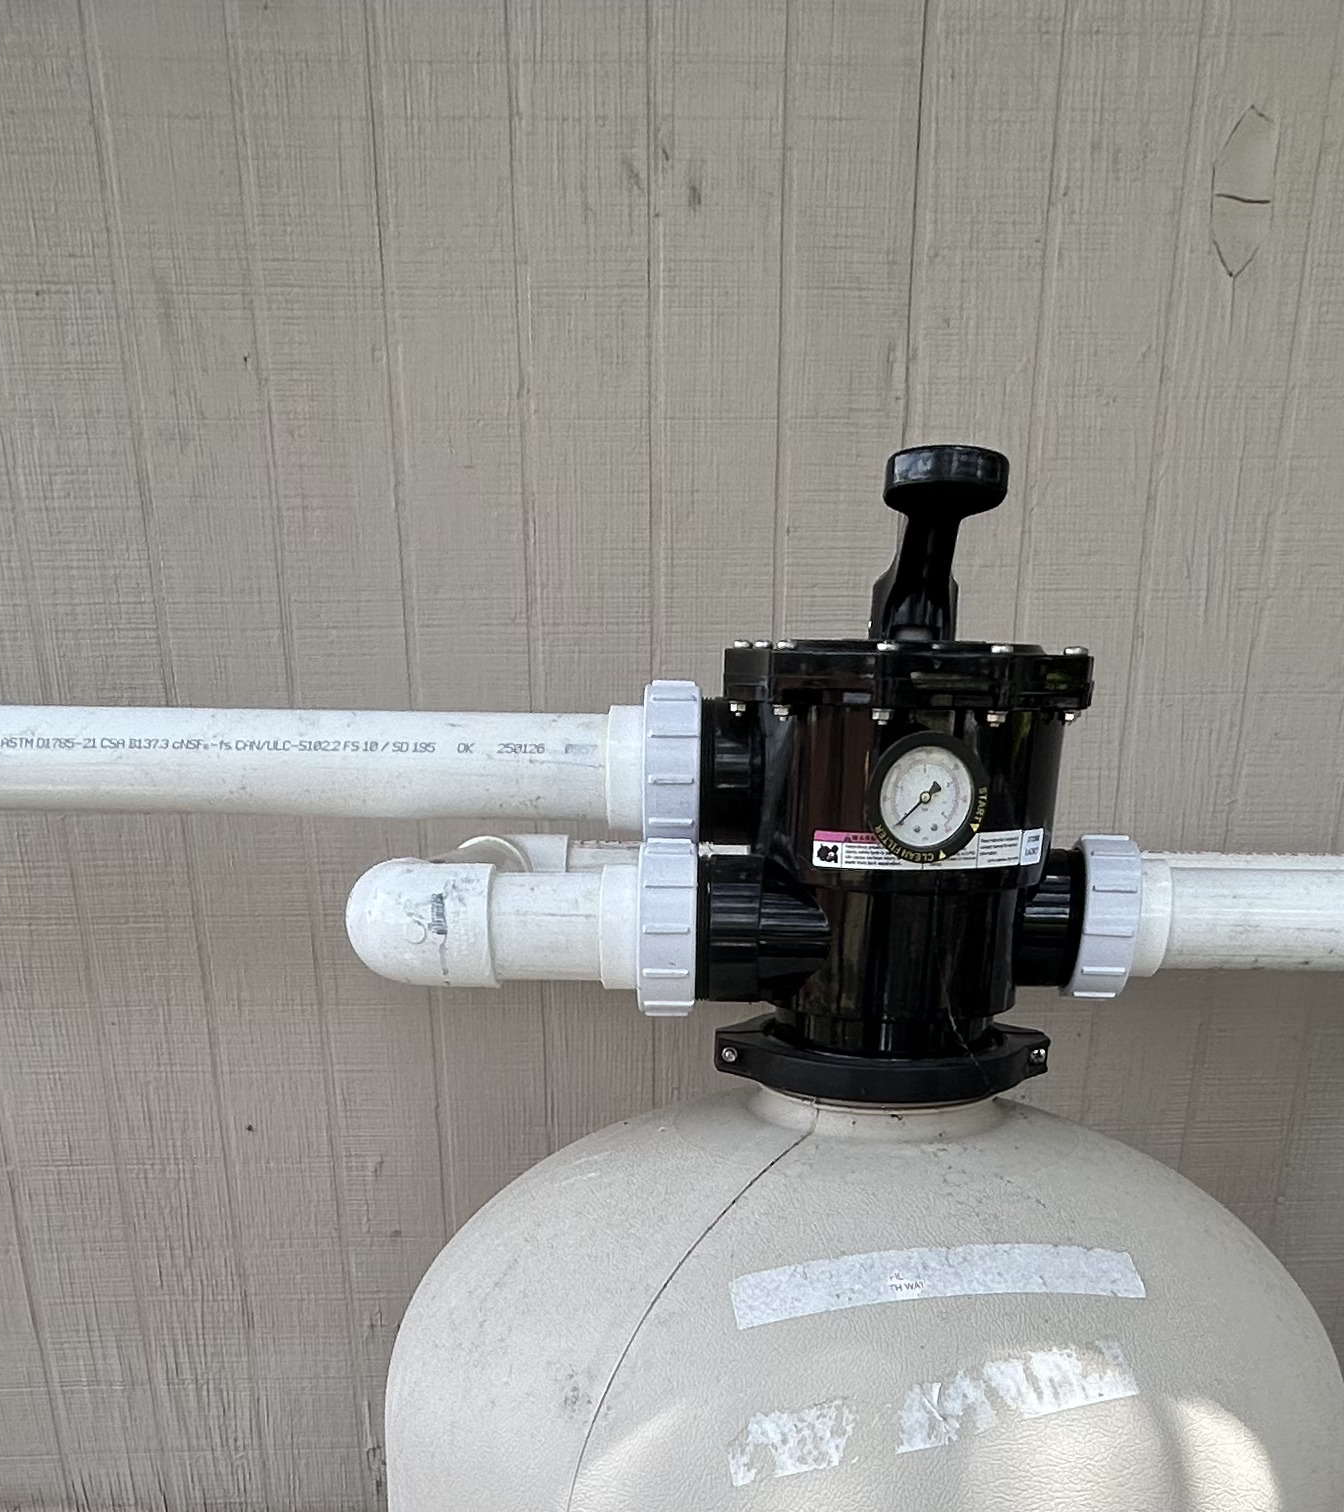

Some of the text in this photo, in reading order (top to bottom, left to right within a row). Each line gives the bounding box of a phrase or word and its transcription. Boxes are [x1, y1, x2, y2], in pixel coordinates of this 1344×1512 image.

[0, 736, 34, 748] ASTM
[100, 737, 125, 749] CSA
[343, 740, 359, 751] FS
[364, 740, 378, 751] 10
[392, 741, 409, 752] SD
[412, 741, 436, 753] 195
[456, 742, 475, 753] OK
[497, 742, 545, 754] 250126
